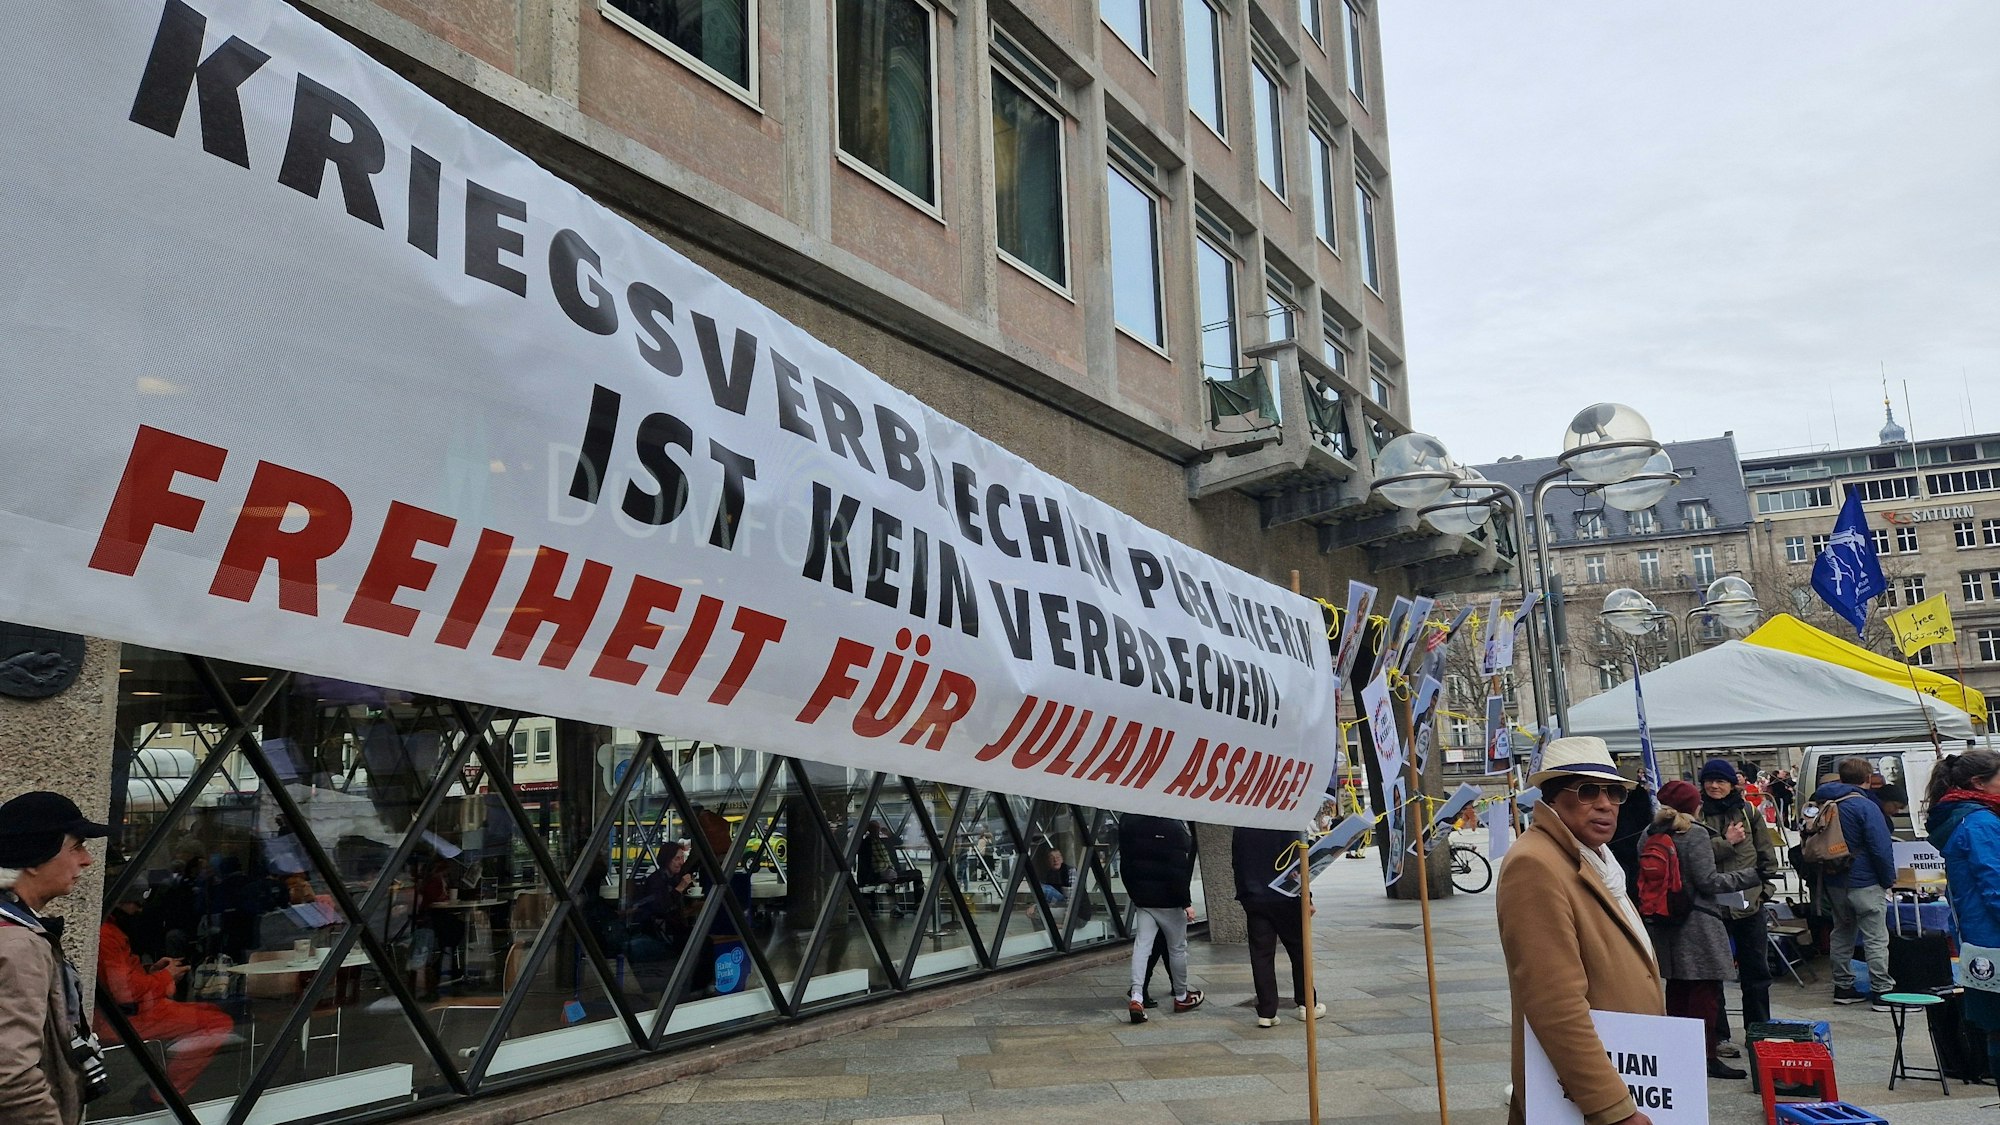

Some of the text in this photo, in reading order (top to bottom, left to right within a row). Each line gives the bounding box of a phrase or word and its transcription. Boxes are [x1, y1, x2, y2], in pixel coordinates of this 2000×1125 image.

[129, 0, 1122, 596] KRIEGSVERBECHN
[88, 424, 1313, 811] FREIHEIT FÜR JULIAN ASSANGE!
[568, 383, 1280, 729] IST KEIN VERBRECHEN!
[1912, 504, 1974, 523] SATURN
[1909, 862, 1945, 870] FREIHEIT
